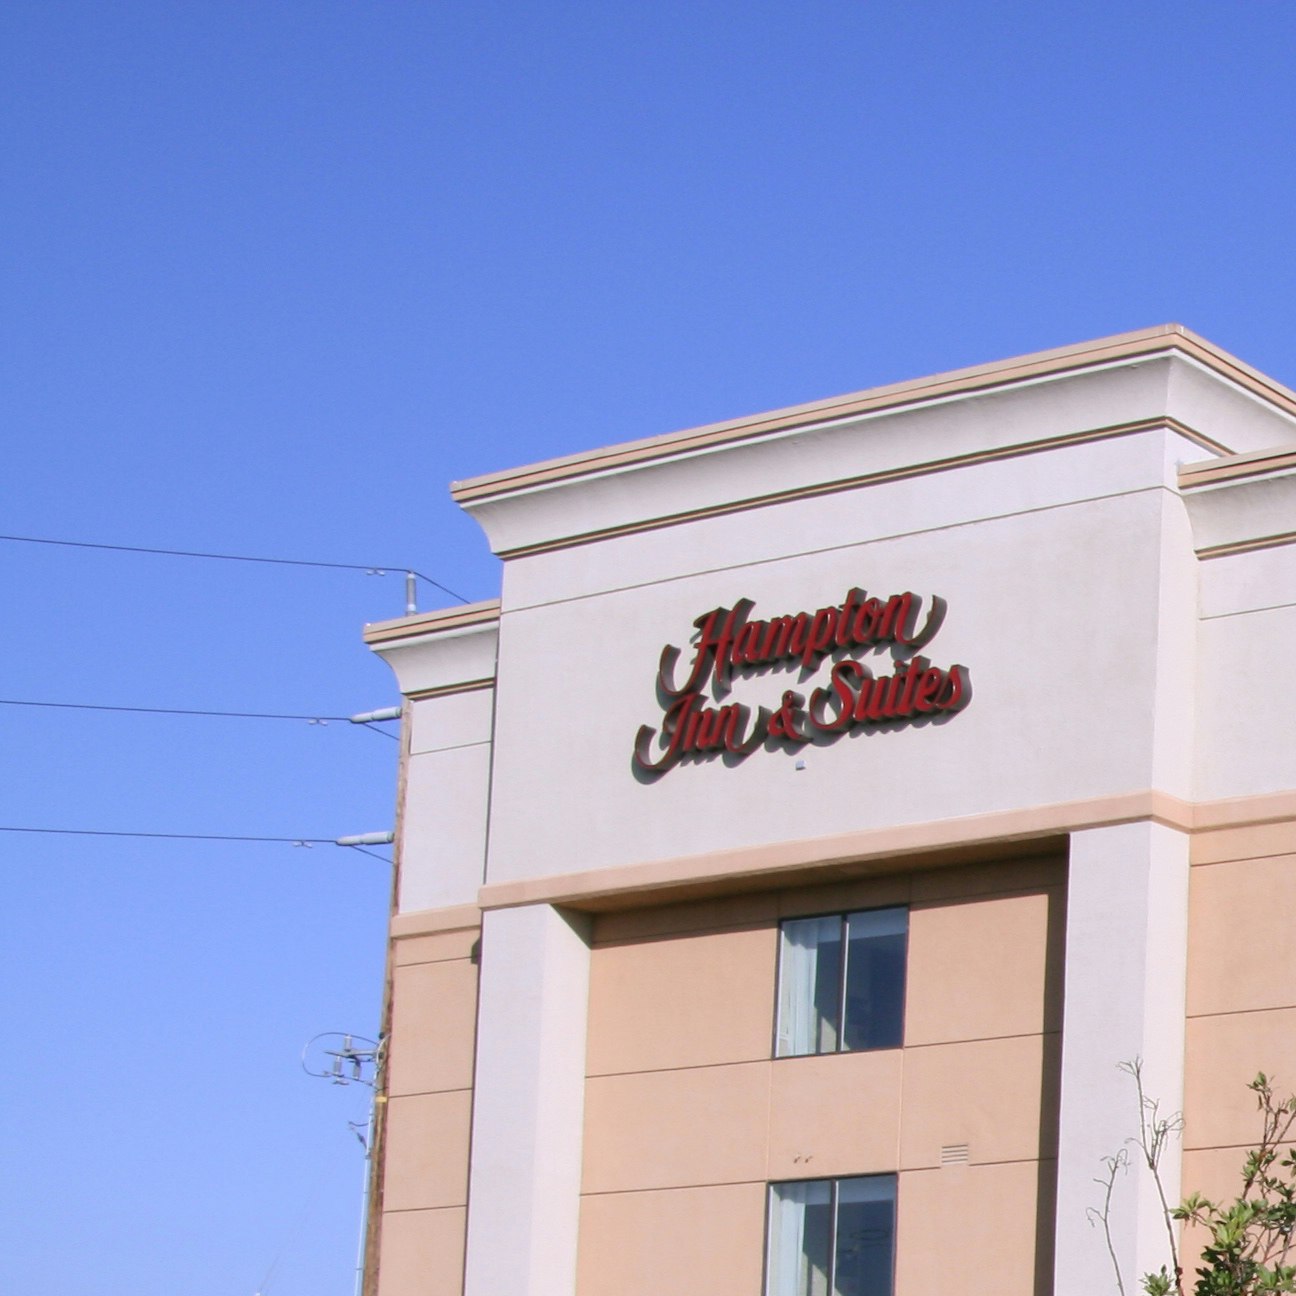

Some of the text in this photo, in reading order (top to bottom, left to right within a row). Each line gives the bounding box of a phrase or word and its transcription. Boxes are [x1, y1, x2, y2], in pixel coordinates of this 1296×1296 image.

[659, 587, 947, 697] Hampton
[634, 655, 971, 770] Inn & Suites
